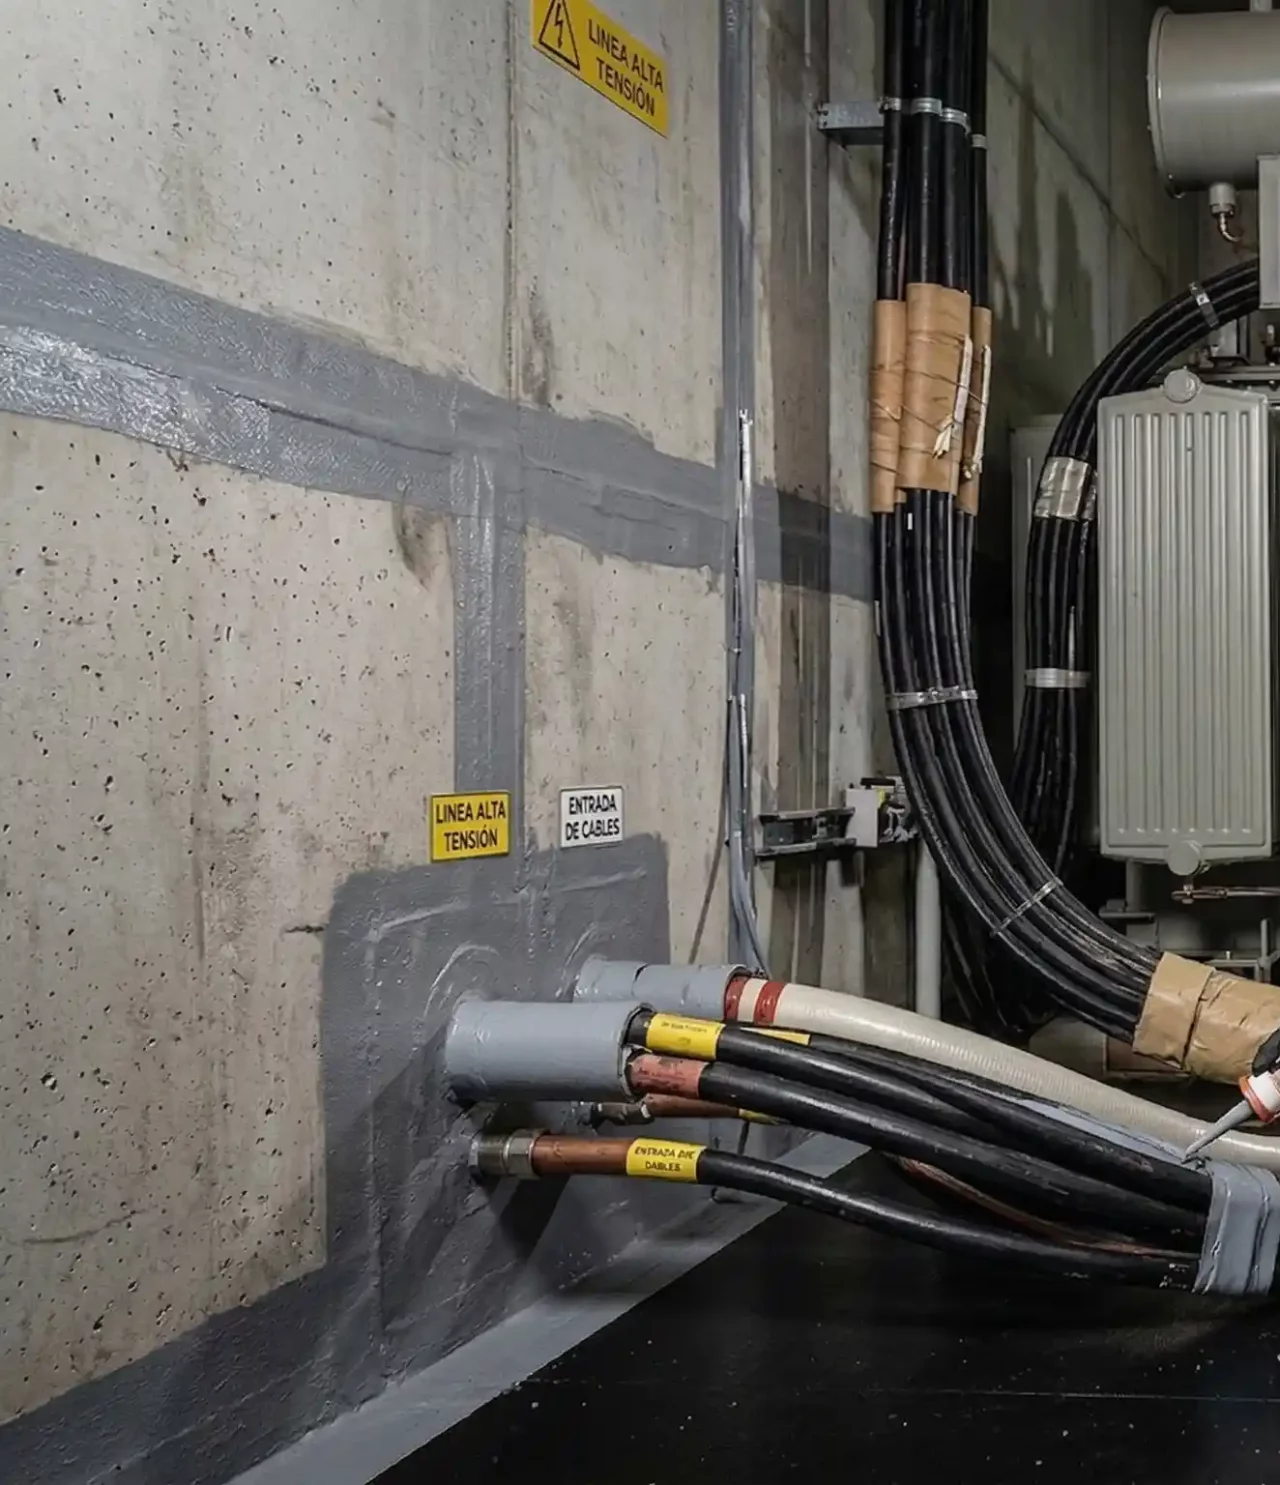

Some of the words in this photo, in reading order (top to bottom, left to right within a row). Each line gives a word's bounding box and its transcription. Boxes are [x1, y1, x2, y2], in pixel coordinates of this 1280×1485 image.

[588, 18, 629, 68] LINEA
[631, 53, 664, 93] ALTA
[596, 56, 655, 117] TENSIÓN
[435, 803, 473, 824] LINEA
[476, 800, 506, 821] ALTA
[568, 794, 617, 815] ENTRADA
[444, 825, 498, 852] TENSIÓN
[565, 822, 580, 841] DE
[582, 818, 620, 839] CABLES
